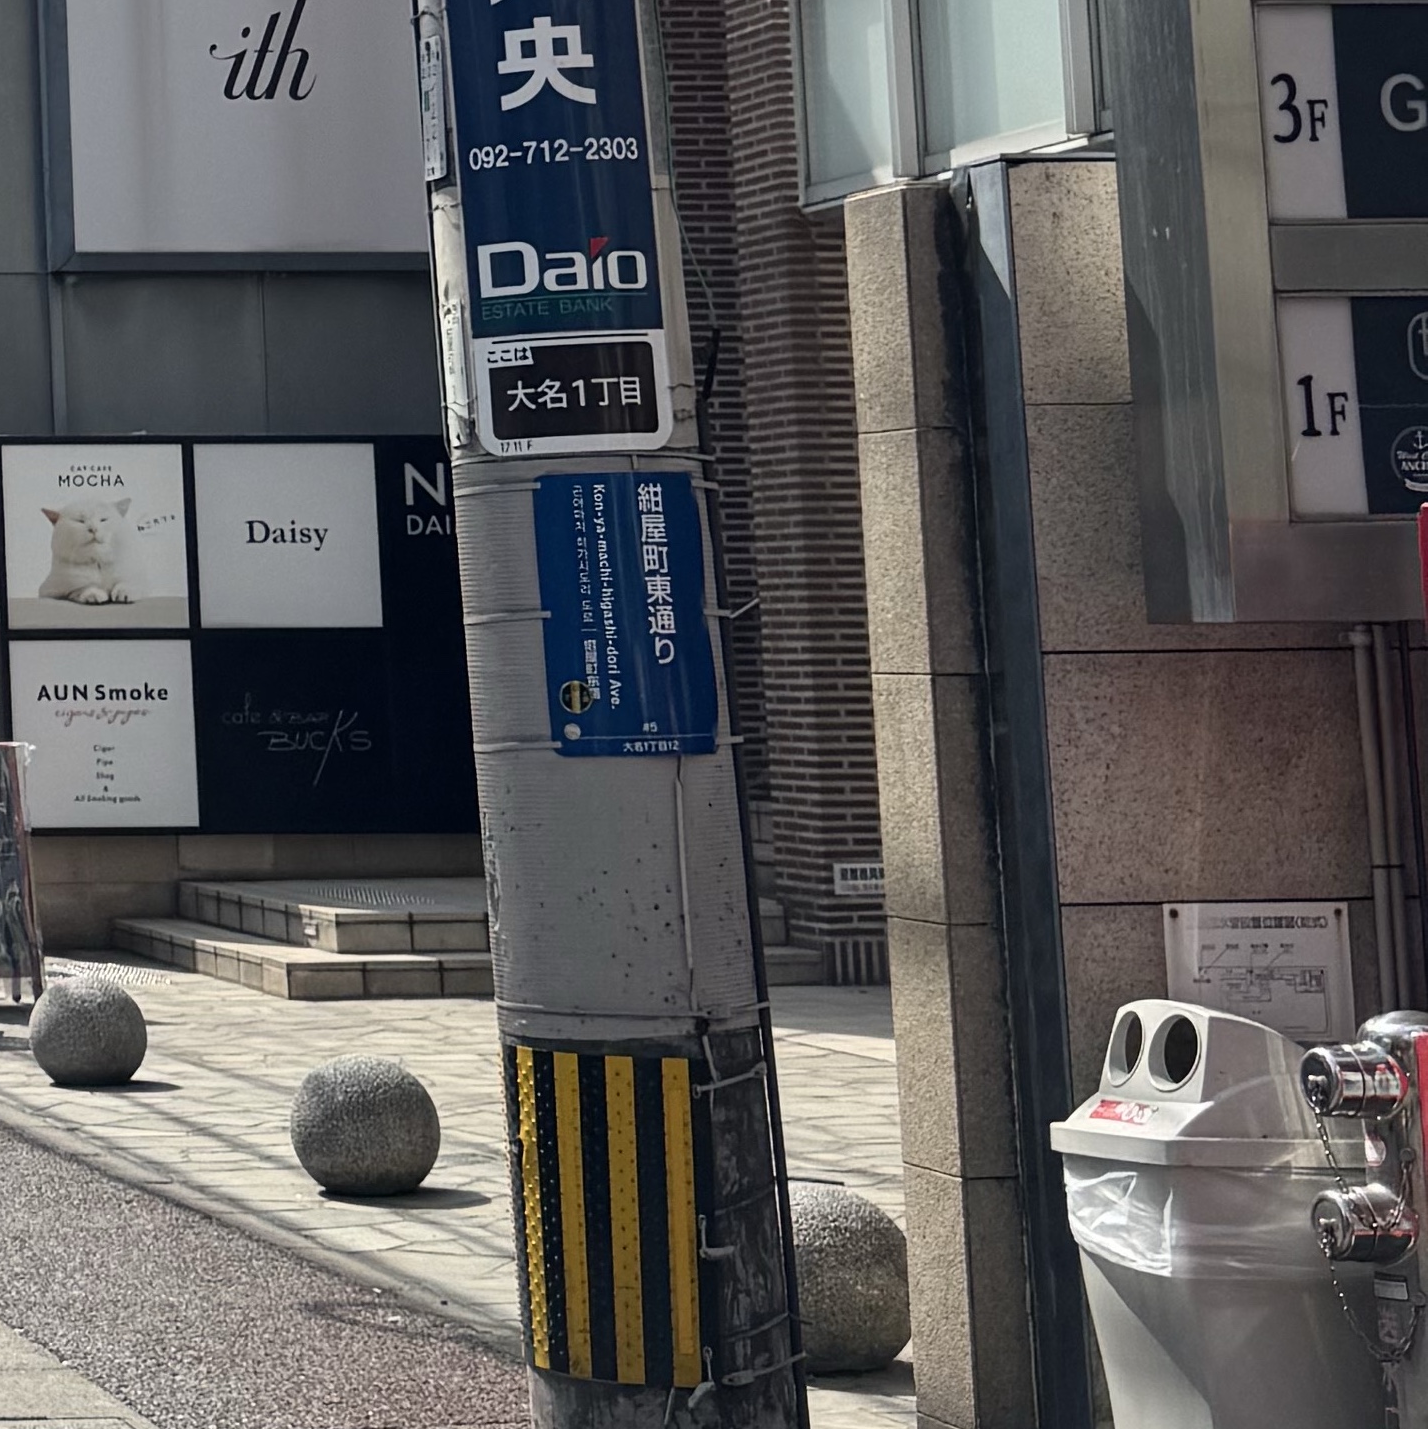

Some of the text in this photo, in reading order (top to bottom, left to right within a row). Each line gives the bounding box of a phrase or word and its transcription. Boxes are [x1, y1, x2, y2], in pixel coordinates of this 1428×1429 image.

[1270, 72, 1329, 144] 3F
[468, 136, 639, 171] 092-712-2303
[476, 237, 648, 299] Daio
[481, 296, 614, 321] ESTATE BANK
[487, 347, 530, 364] ここは
[506, 376, 642, 412] 大名1丁目
[1297, 374, 1349, 437] 1F
[58, 474, 125, 487] MOCHA
[245, 519, 329, 552] Daisy
[637, 482, 677, 664] 紺屋町東通り
[37, 682, 169, 702] AUN Smoke
[257, 710, 373, 787] BUCKS
